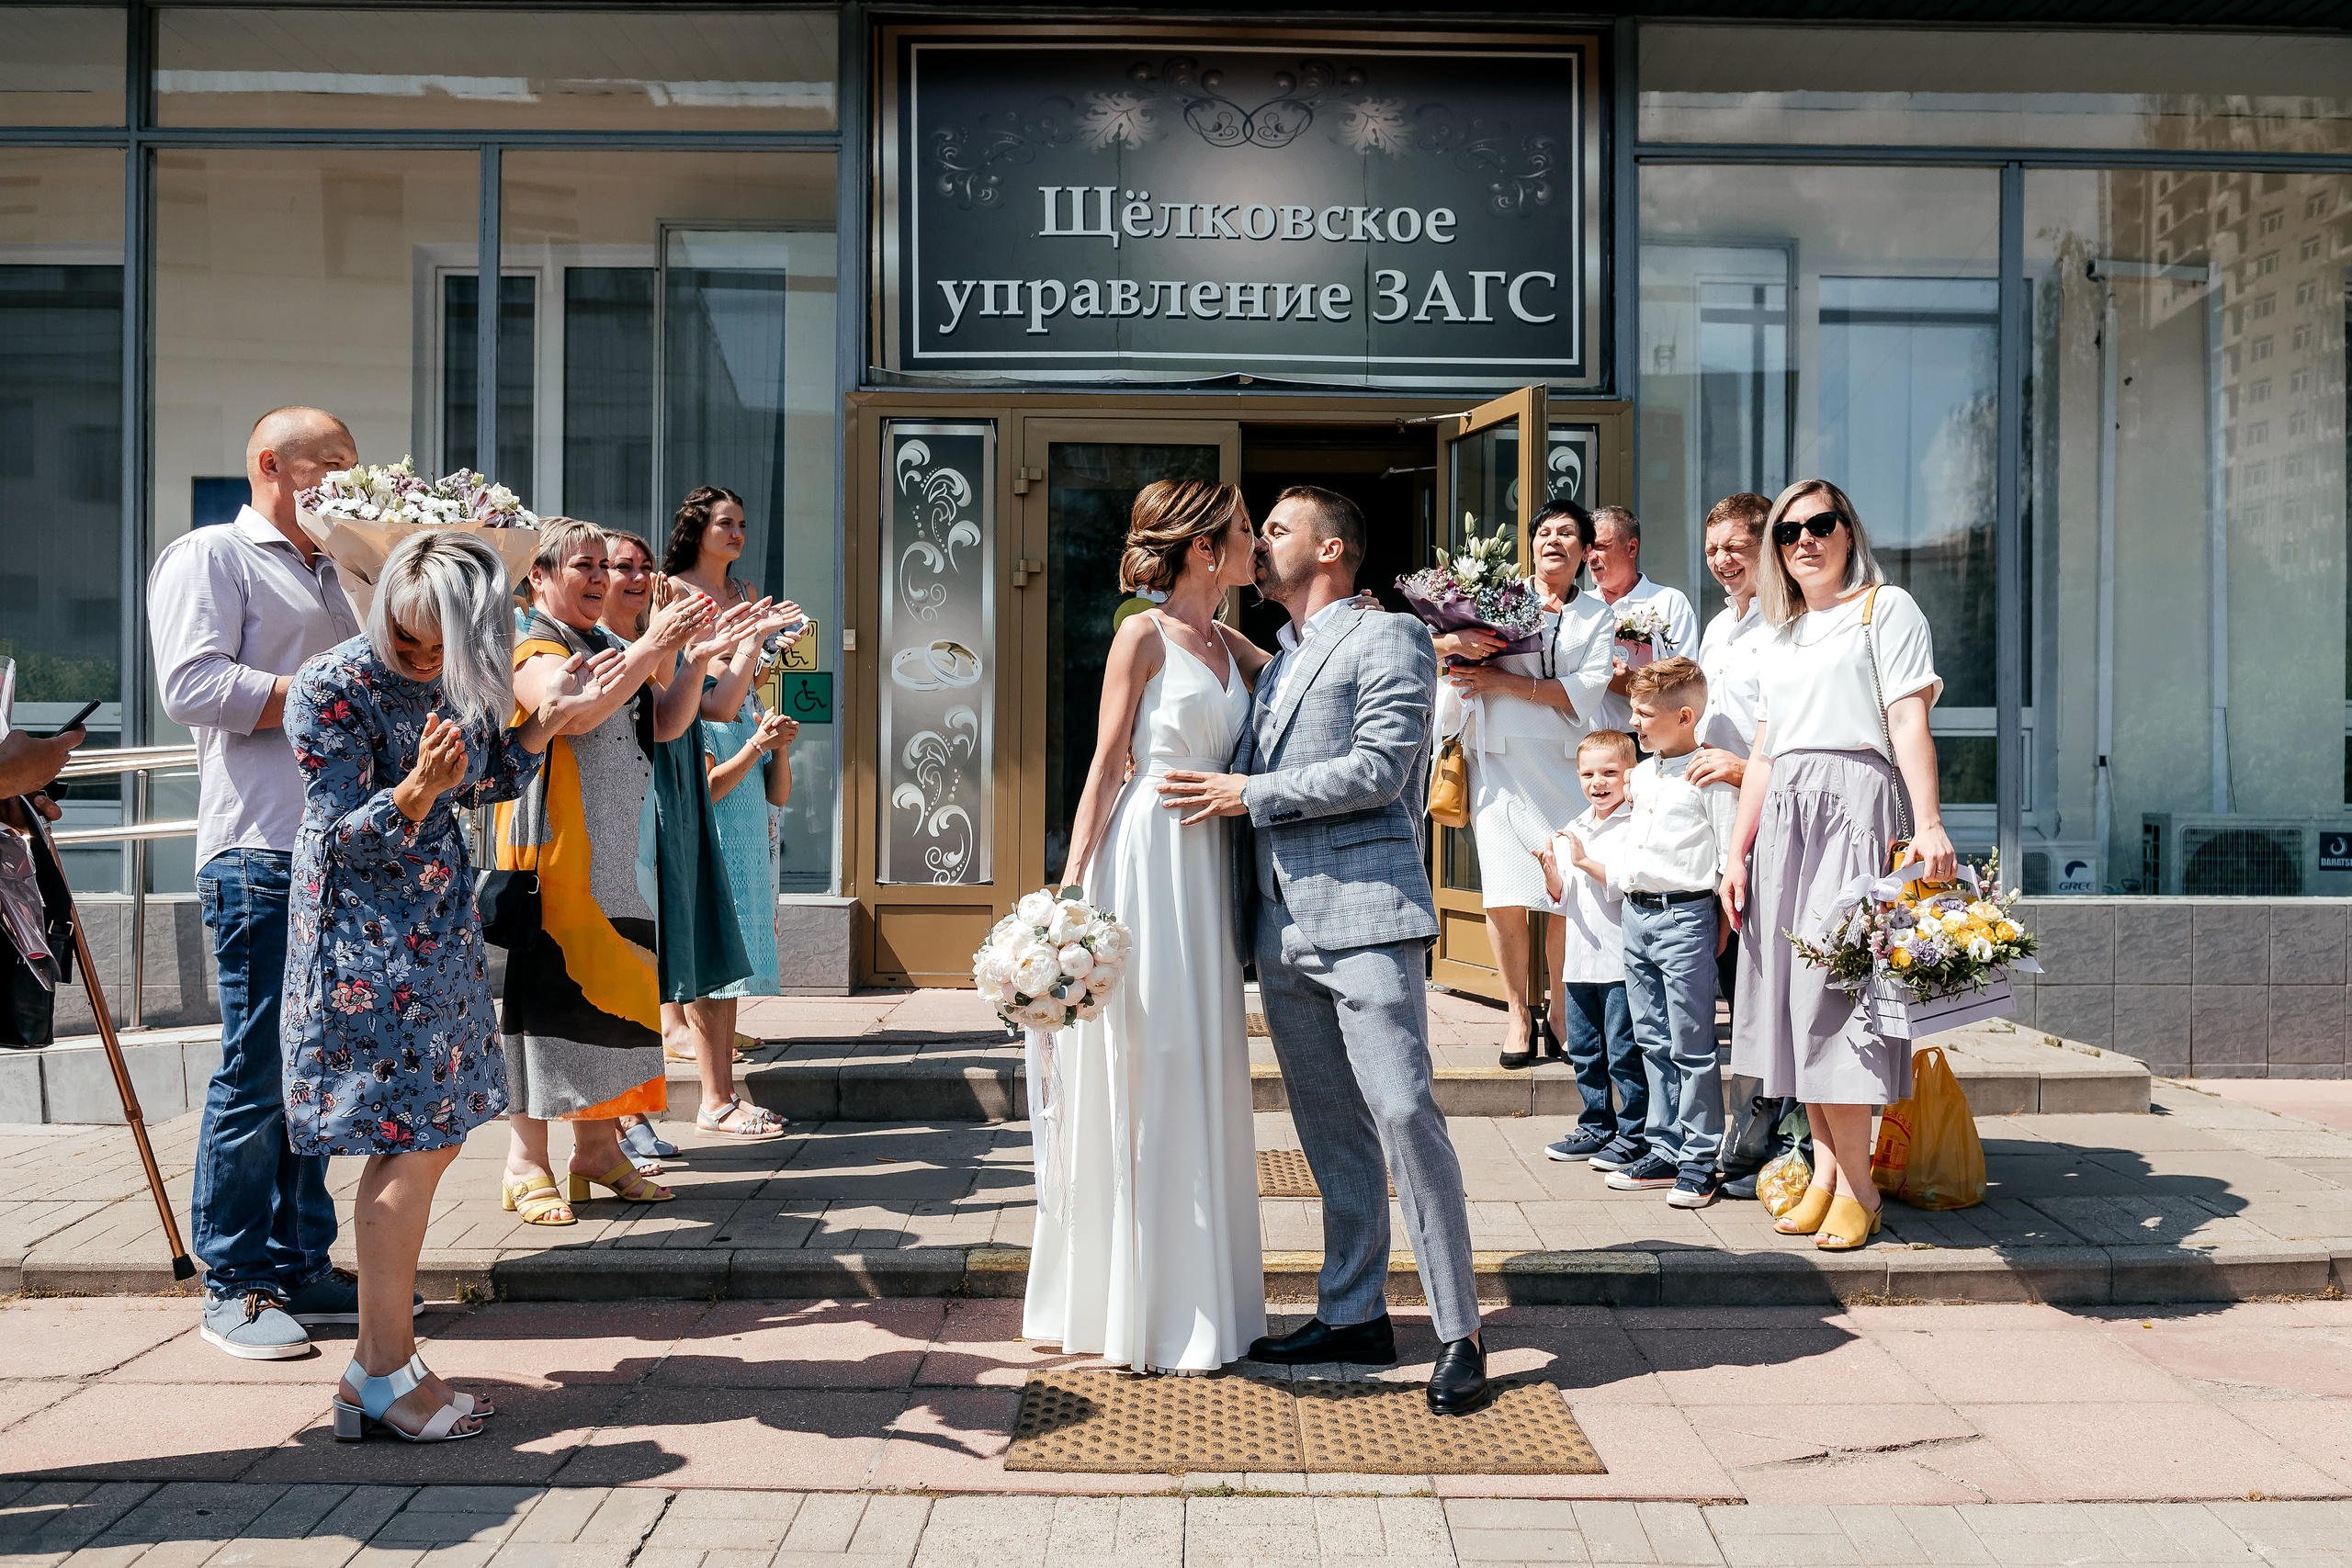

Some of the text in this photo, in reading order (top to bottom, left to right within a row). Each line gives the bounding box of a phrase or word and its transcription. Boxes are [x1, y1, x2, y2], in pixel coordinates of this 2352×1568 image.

[1038, 185, 1457, 248] Щёлковское
[937, 269, 1556, 333] управление ЗАГС
[2321, 857, 2352, 867] DAHATS
